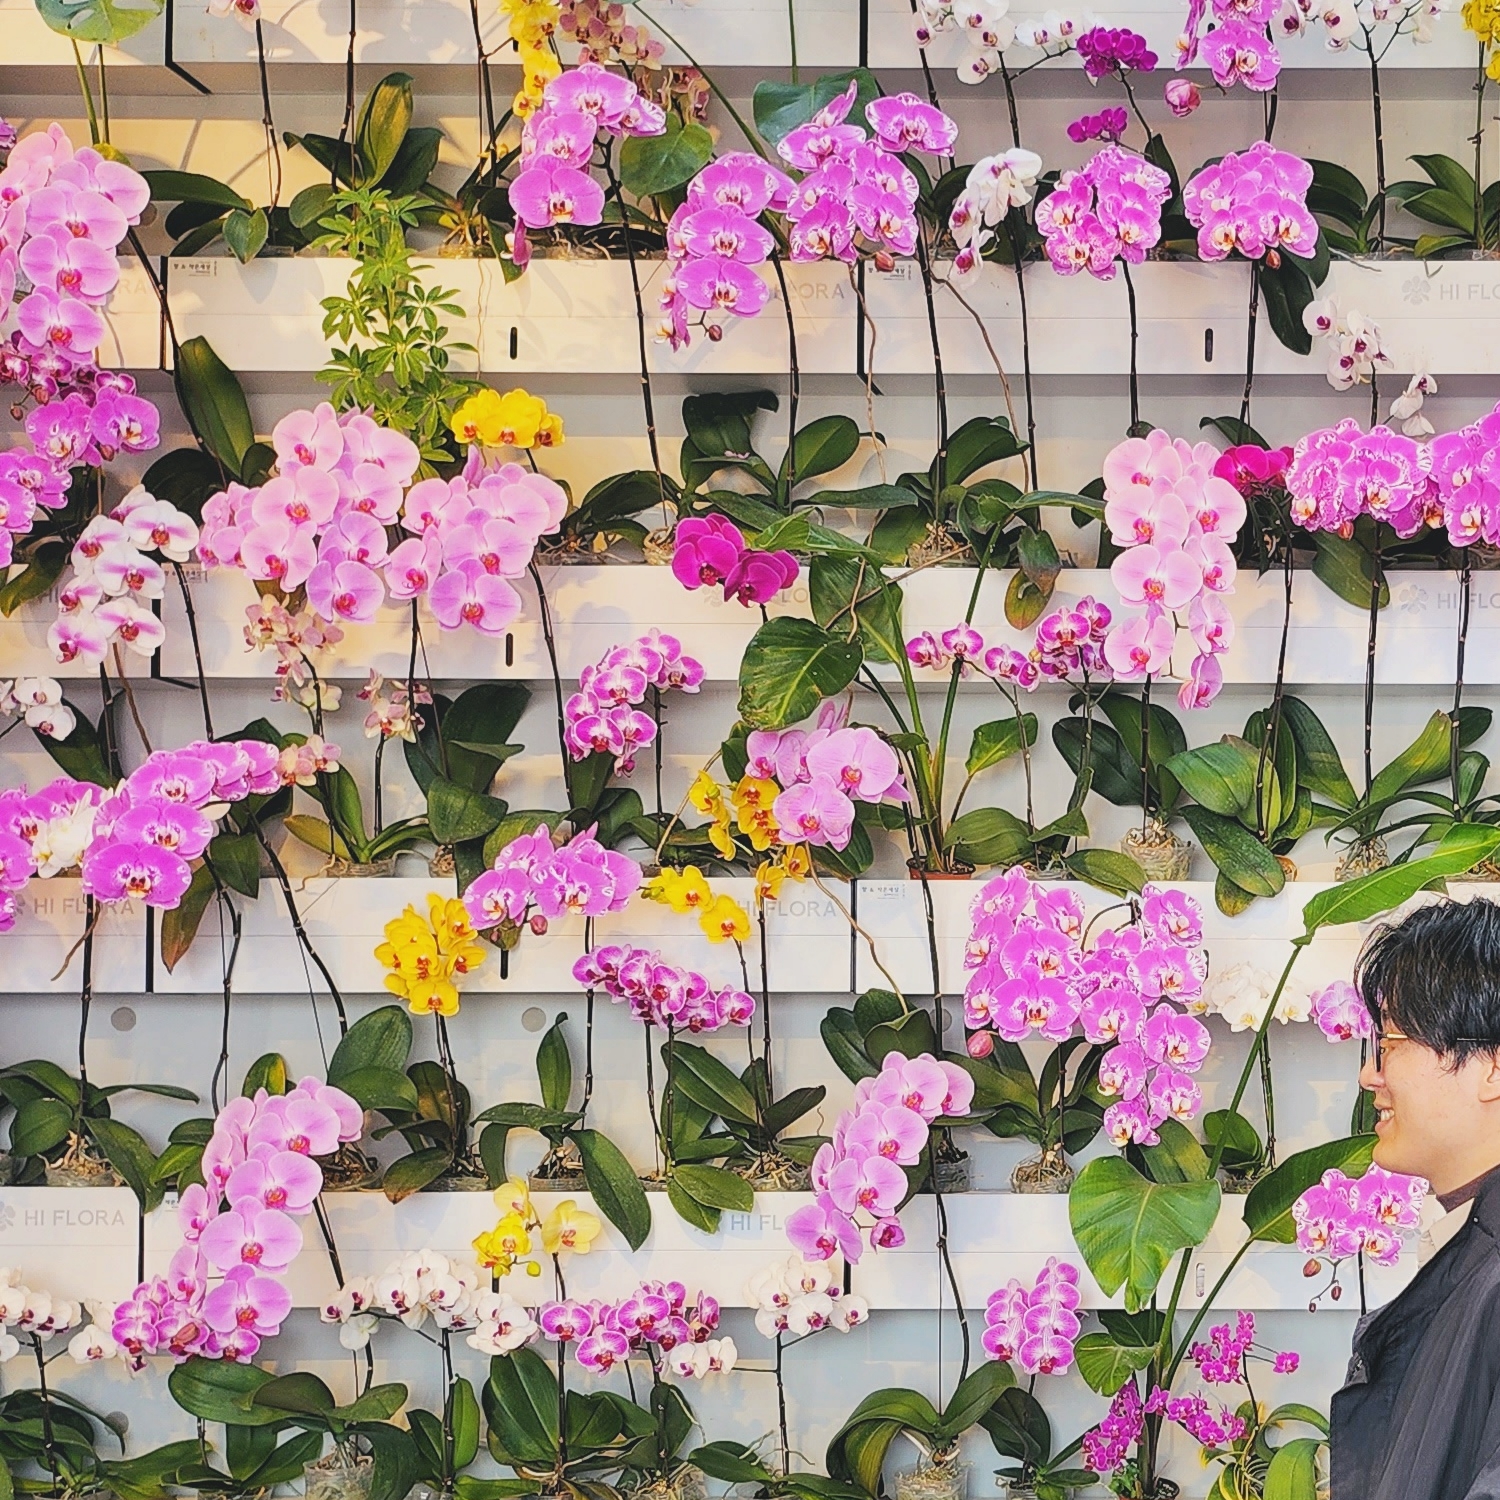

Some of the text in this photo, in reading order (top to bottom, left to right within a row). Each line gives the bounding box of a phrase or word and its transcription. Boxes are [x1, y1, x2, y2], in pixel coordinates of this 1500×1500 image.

[1439, 284, 1459, 300] HI
[1437, 593, 1457, 609] HI
[34, 898, 54, 914] HI
[766, 900, 837, 917] FLORA
[24, 1209, 125, 1226] HI FLORA
[732, 1214, 750, 1231] HI
